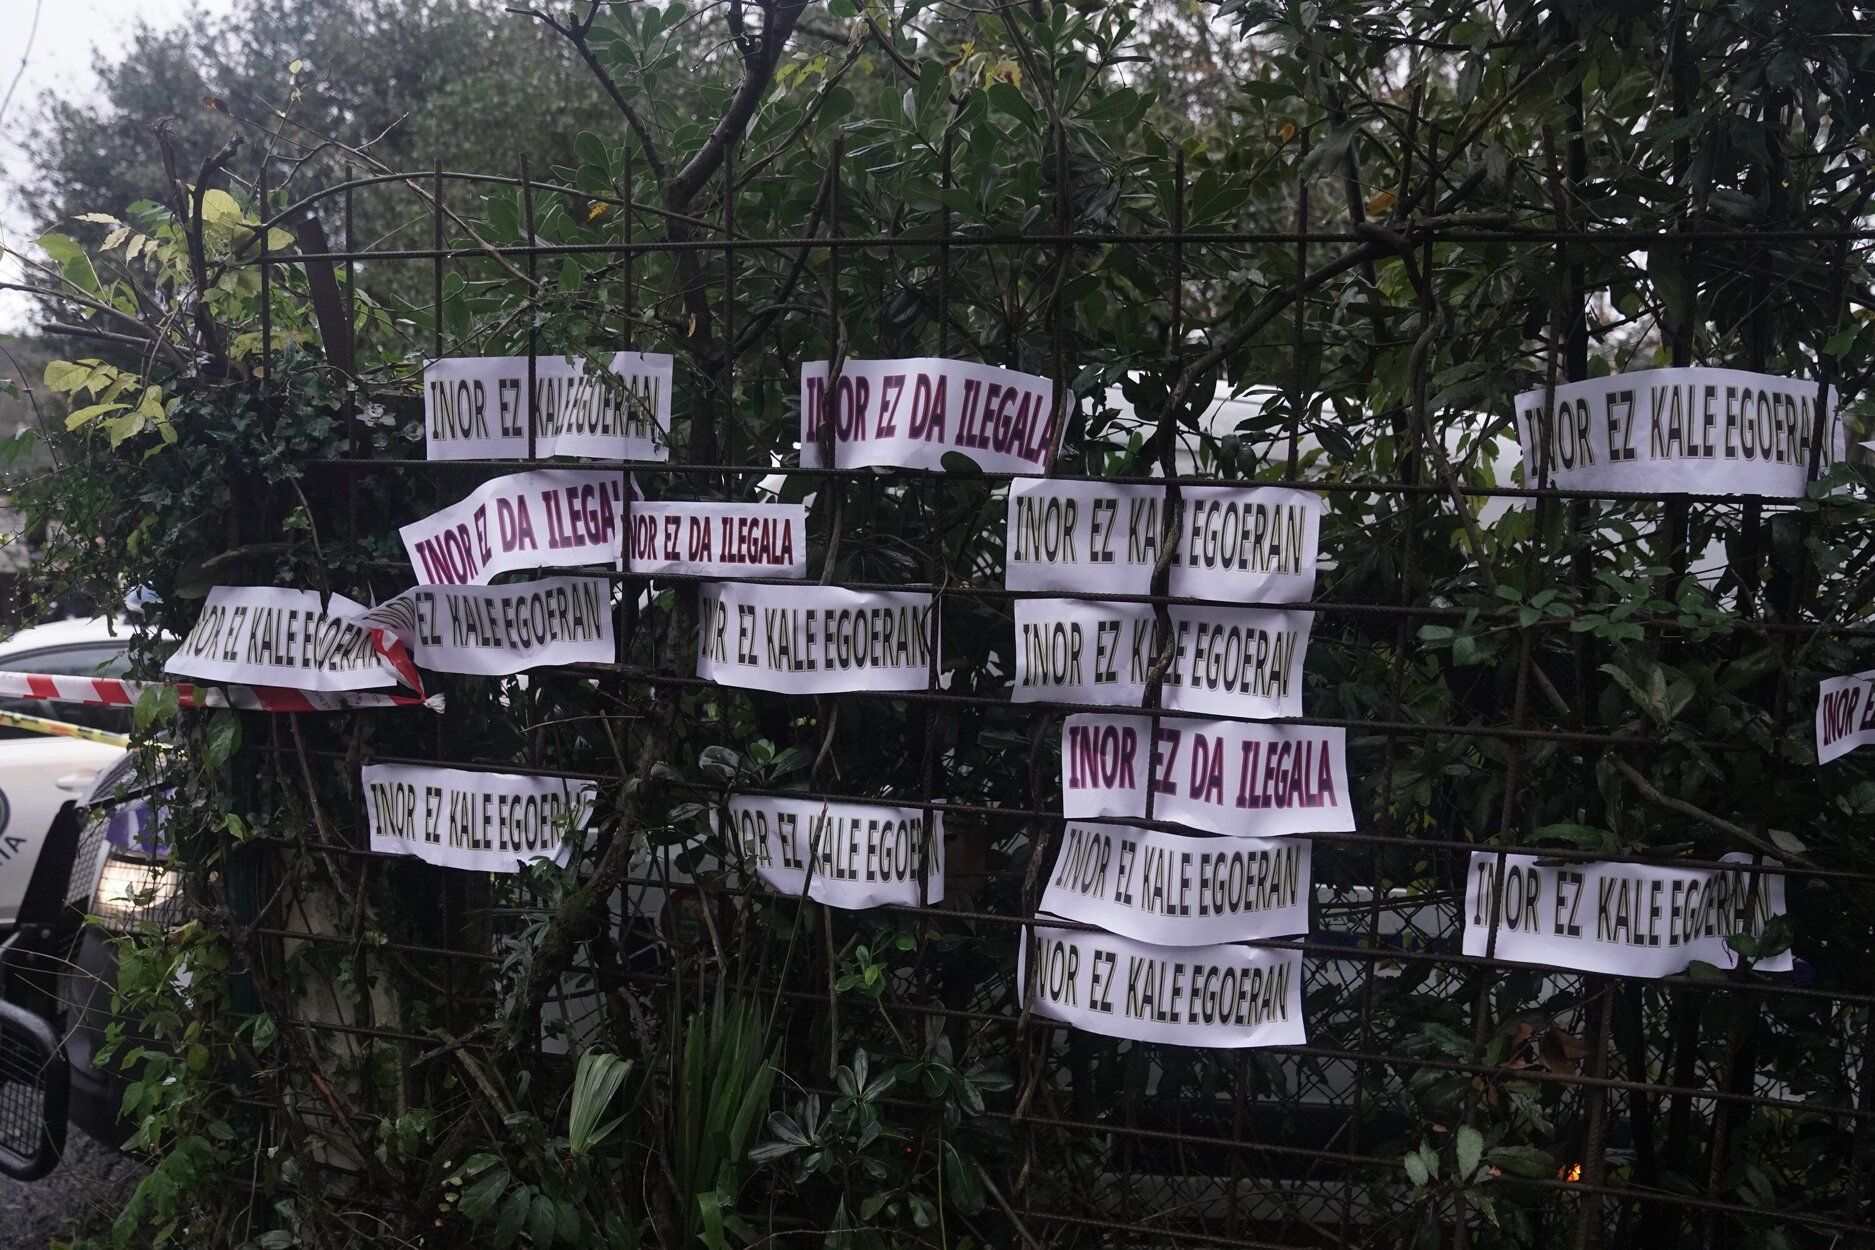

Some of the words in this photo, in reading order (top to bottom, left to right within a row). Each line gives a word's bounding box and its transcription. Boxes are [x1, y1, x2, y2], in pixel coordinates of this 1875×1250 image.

[431, 379, 490, 441] INOR
[498, 378, 524, 438] EZ
[874, 375, 906, 439] EZ
[907, 373, 947, 443] DA
[1606, 389, 1638, 463] EZ
[1650, 384, 1717, 460] KALE
[414, 522, 479, 585] INOR
[473, 503, 493, 568] EZ
[496, 494, 538, 553] DA
[541, 480, 639, 550] ILEGA
[620, 514, 658, 560] NOR
[664, 516, 681, 561] EZ
[689, 517, 712, 562] DA
[720, 517, 793, 566] ILEGALA
[1014, 496, 1077, 564] INOR
[1090, 496, 1119, 564] EZ
[1128, 496, 1188, 567] KA
[1188, 498, 1306, 575] EGOERAN
[222, 606, 248, 663] EZ
[247, 607, 299, 667] KALE
[415, 592, 443, 647] EZ
[447, 593, 502, 649] KALE
[502, 581, 604, 651] EGOERAN
[737, 604, 759, 666] EZ
[765, 606, 817, 672] KALE
[823, 605, 928, 669] EGOERAN
[1021, 621, 1083, 687] INOR
[1095, 619, 1121, 684] EZ
[1130, 618, 1191, 687] KAE
[1823, 686, 1861, 747] INOR
[1069, 725, 1137, 789] INOR
[1154, 728, 1181, 795] EZ
[1189, 733, 1224, 806] DA
[1235, 740, 1338, 809] ILEGALA
[370, 783, 416, 840] INOR
[424, 786, 442, 845] EZ
[450, 790, 493, 851] KALE
[777, 812, 805, 869] EZ
[1055, 829, 1112, 900] INOR
[1114, 840, 1136, 907] EZ
[1142, 845, 1192, 917] KALE
[1199, 846, 1299, 916] EGOERAN
[1553, 871, 1585, 939] EZ
[1596, 875, 1664, 947] KALE
[1036, 937, 1080, 1007] NOR
[1089, 950, 1118, 1014] EZ
[1126, 956, 1186, 1024] KALE
[1187, 961, 1292, 1027] EGOERAN
